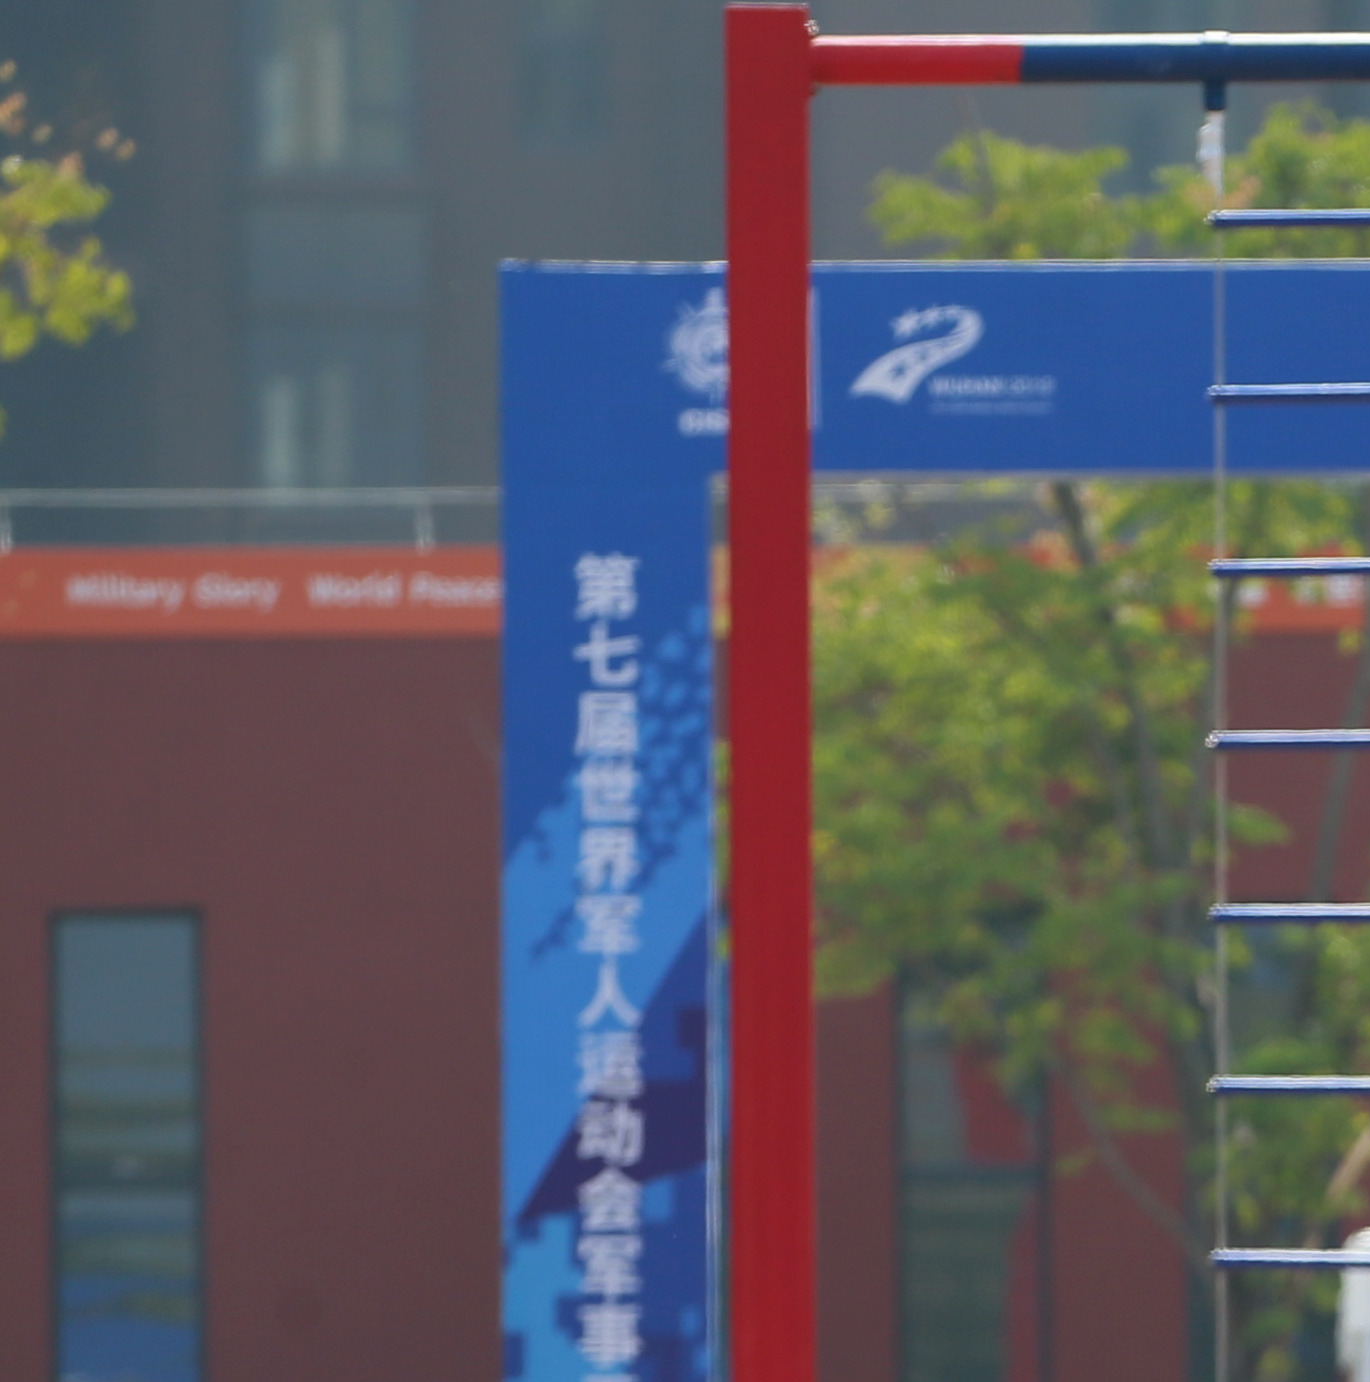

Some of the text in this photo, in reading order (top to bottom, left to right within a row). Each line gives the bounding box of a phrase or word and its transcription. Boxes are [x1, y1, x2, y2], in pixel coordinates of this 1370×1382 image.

[65, 571, 186, 615] Military
[191, 571, 281, 614] Glory
[305, 570, 402, 608] World
